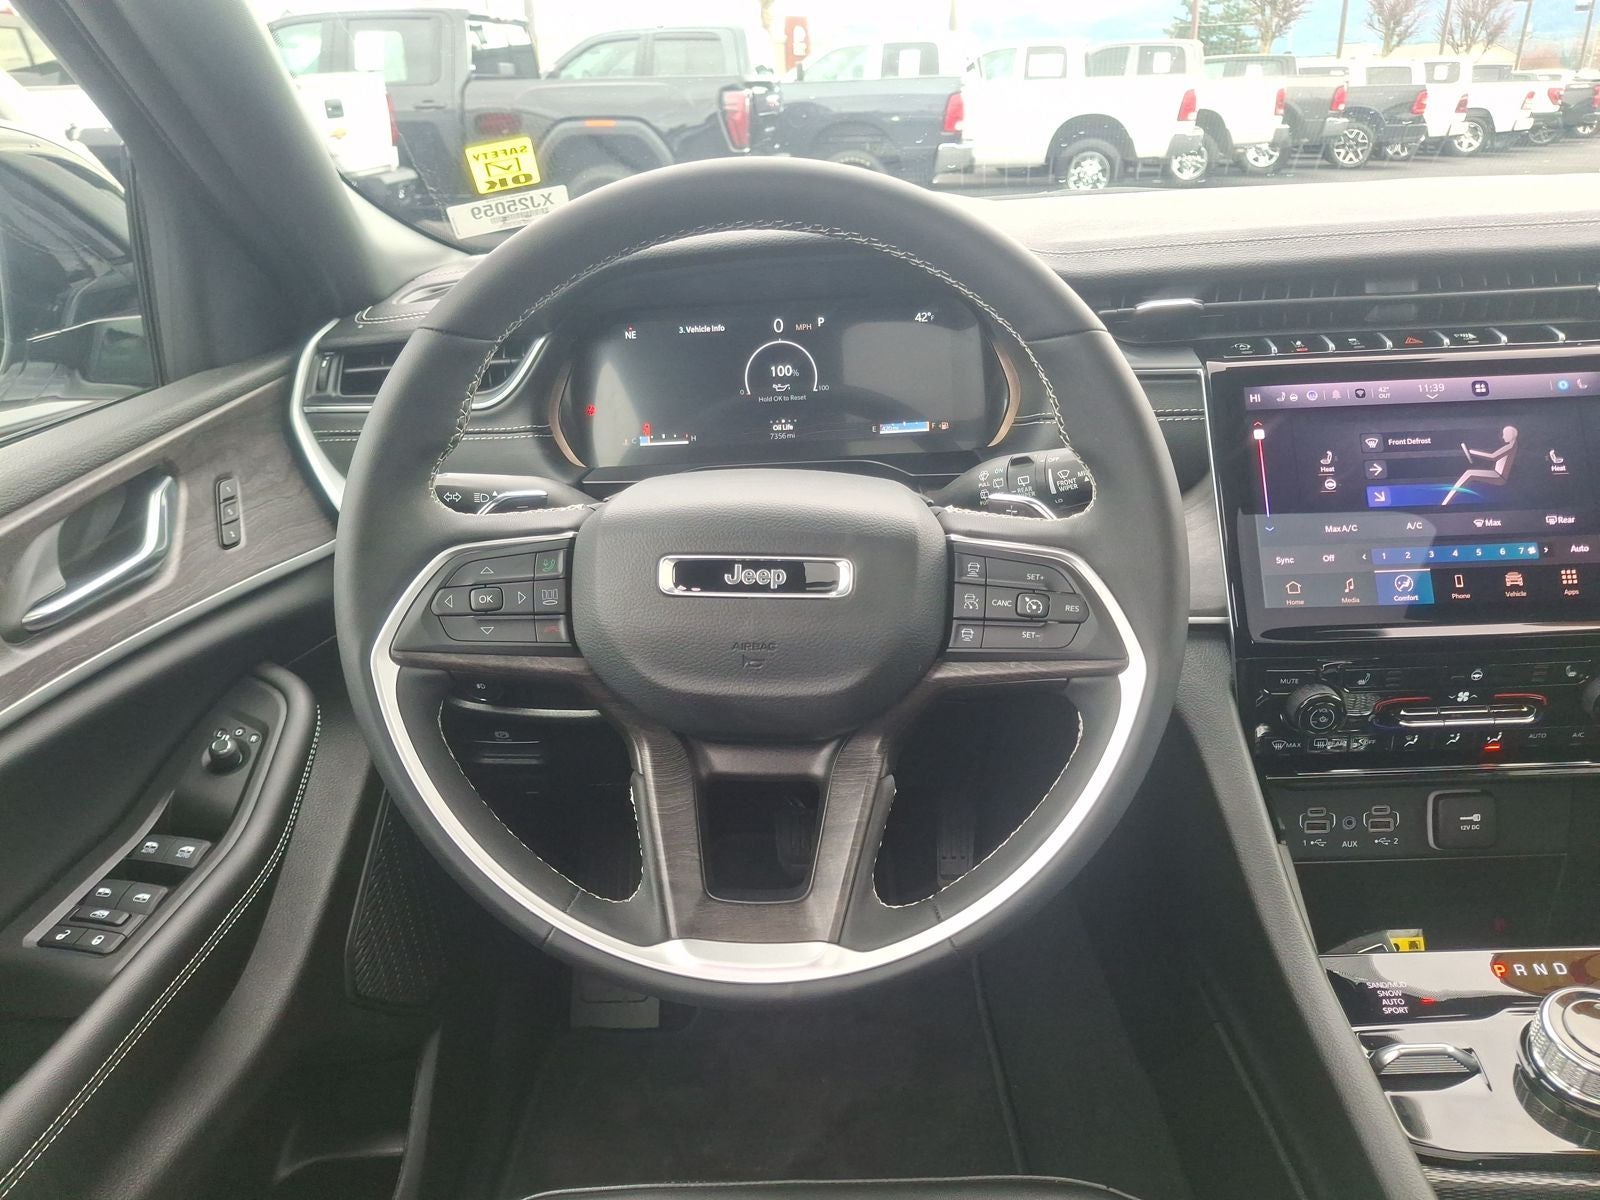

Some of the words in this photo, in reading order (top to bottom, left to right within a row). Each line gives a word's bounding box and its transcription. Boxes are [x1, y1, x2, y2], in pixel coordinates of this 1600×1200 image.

[773, 318, 784, 333] 0
[817, 316, 825, 327] P
[686, 325, 711, 334] Vehicle
[711, 324, 726, 333] Info
[795, 323, 812, 331] MPH
[624, 330, 637, 340] NE
[1418, 383, 1445, 393] 11:39
[772, 423, 782, 431] Oil
[782, 423, 794, 431] Life
[1388, 438, 1406, 446] Front
[1407, 437, 1432, 445] Defrost
[1551, 464, 1566, 472] Heat
[1056, 477, 1077, 487] FRONT
[1058, 483, 1079, 492] WIPER
[1485, 518, 1502, 527] Max
[1558, 515, 1576, 524] Rear
[1325, 525, 1343, 533] Max
[1342, 524, 1359, 532] A/C
[1406, 522, 1423, 530] A/C
[1570, 544, 1590, 553] Auto
[1322, 554, 1335, 562] Off
[1381, 552, 1387, 560] 1
[1405, 551, 1411, 559] 2
[1428, 550, 1435, 558] 3
[1452, 549, 1458, 557] 4
[1475, 548, 1482, 556] 5
[1499, 547, 1506, 555] 6
[1519, 547, 1525, 555] 7
[1275, 556, 1295, 566] Sync
[723, 563, 787, 589] Jeep
[478, 595, 493, 604] OK
[1065, 604, 1080, 612] RES
[731, 641, 778, 651] AIRBAG
[1341, 840, 1358, 848] AUX
[1393, 837, 1399, 845] 2
[1493, 964, 1506, 977] P
[1513, 964, 1527, 976] R
[1532, 963, 1548, 976] N
[1552, 962, 1568, 975] D
[1366, 981, 1408, 989] SAND/MUD
[1382, 998, 1406, 1006] AUTO
[1382, 1007, 1409, 1015] SPORT
